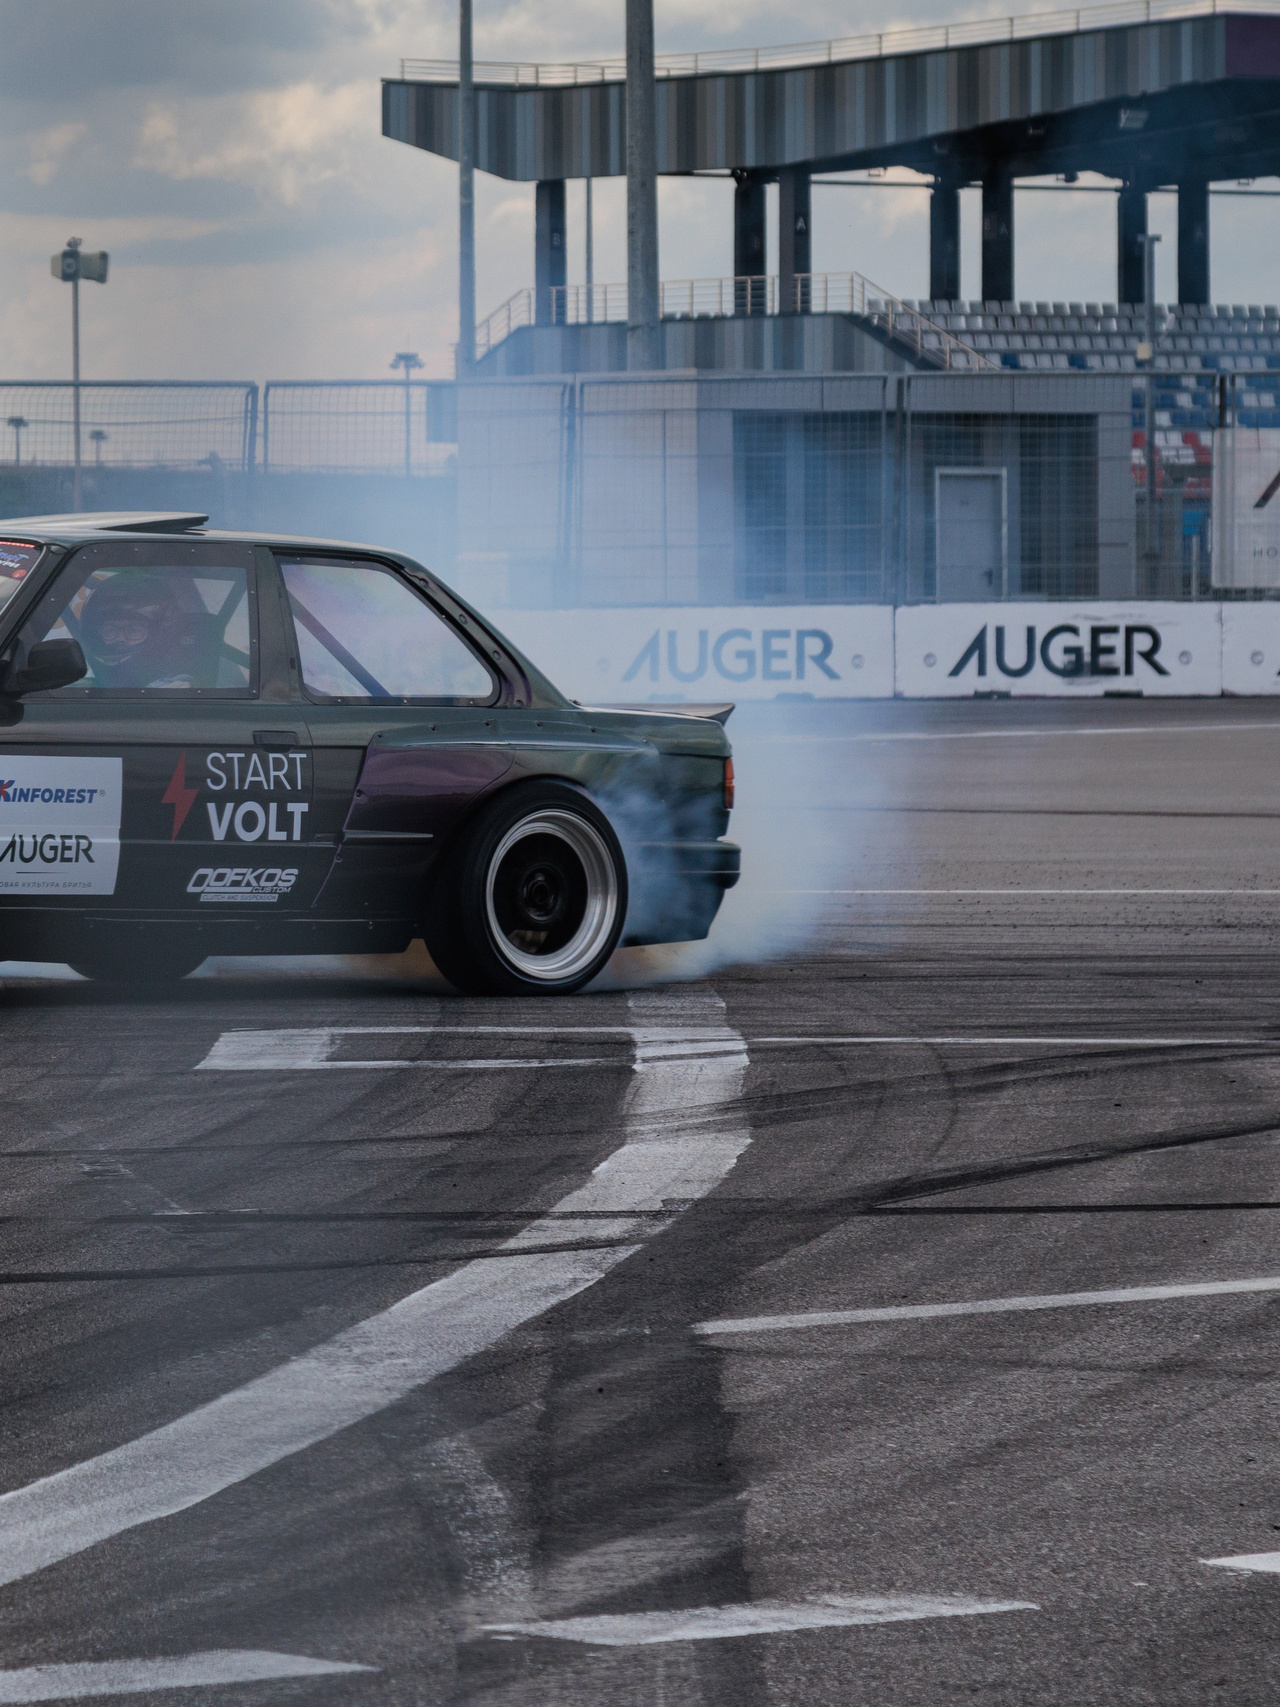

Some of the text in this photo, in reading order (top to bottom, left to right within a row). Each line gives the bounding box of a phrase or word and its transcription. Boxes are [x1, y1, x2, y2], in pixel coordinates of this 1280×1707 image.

[621, 627, 842, 683] AUGER
[947, 621, 1172, 678] AUGER
[206, 752, 308, 791] START
[206, 801, 309, 842] VOLT
[21, 881, 60, 889] КУЛЬТУРА
[62, 881, 93, 889] БРИТЬЯ
